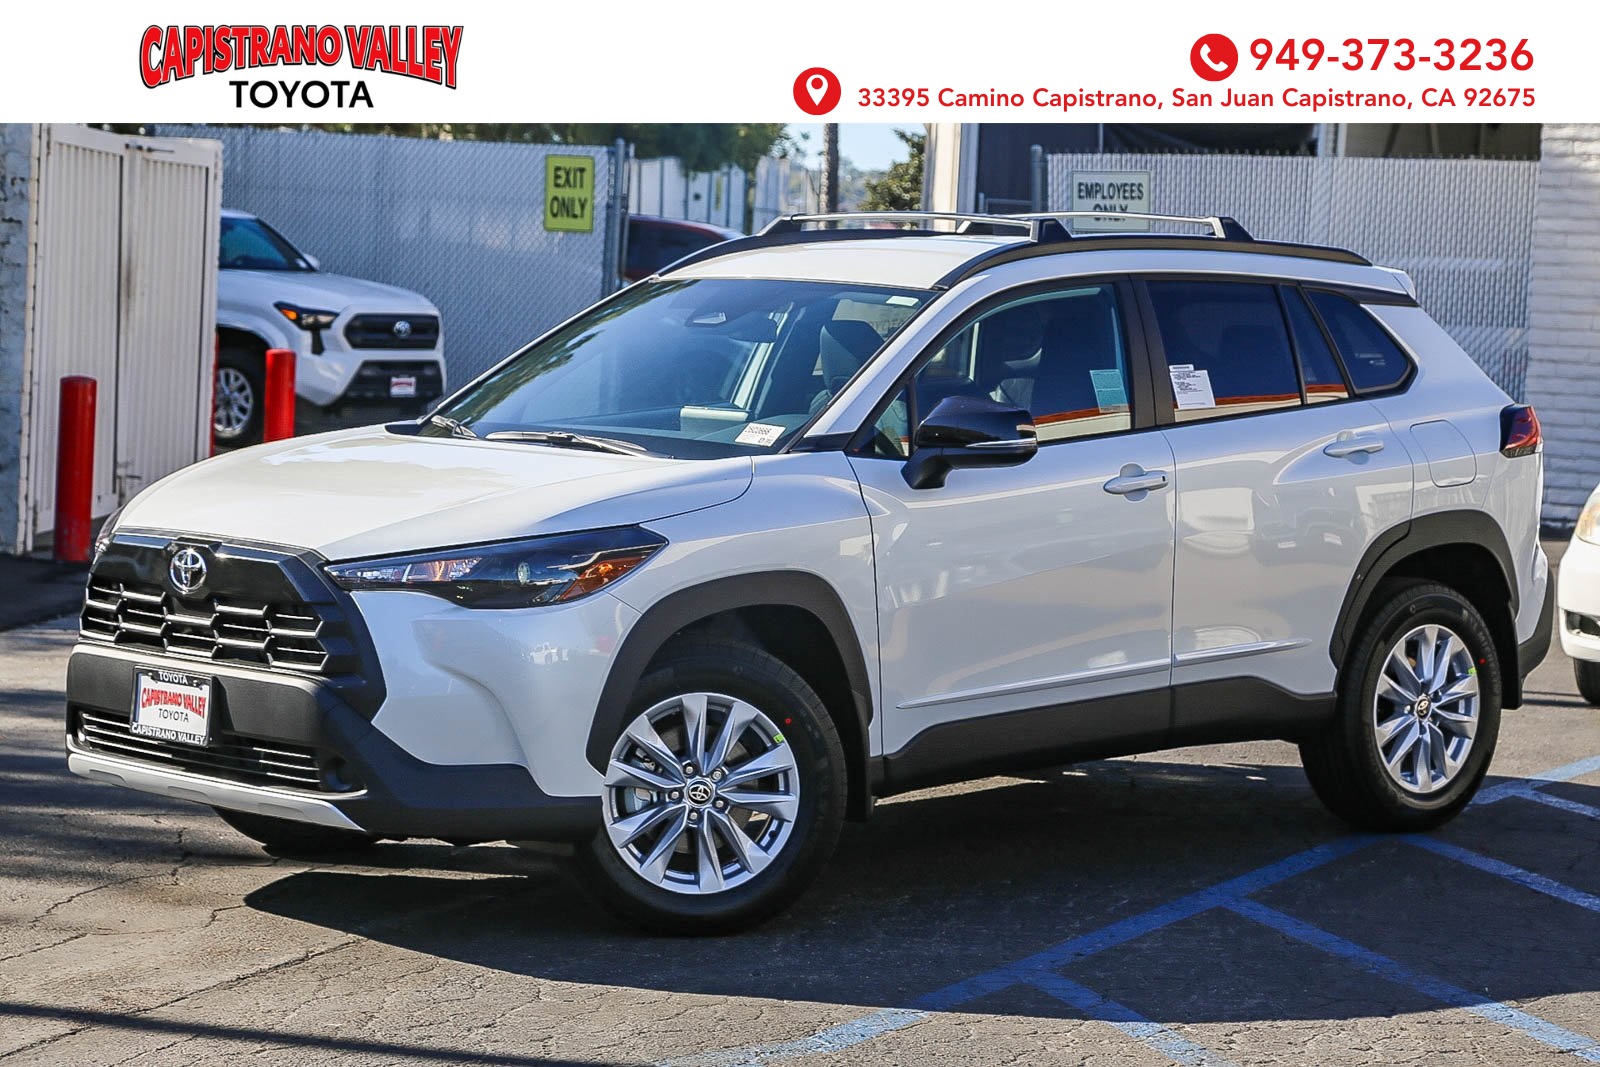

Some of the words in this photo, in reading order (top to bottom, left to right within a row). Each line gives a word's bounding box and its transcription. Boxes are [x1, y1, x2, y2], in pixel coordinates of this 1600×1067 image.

[553, 165, 587, 188] EXIT
[1077, 182, 1144, 200] EMPLOYEES
[549, 195, 588, 219] ONLY
[158, 671, 188, 685] TOYOTA
[141, 687, 182, 709] CAPISTRANO
[183, 693, 206, 719] VALLEY
[158, 708, 189, 722] TOYOTA
[131, 723, 176, 740] CAPISTRANO
[177, 731, 205, 745] VALLEY
